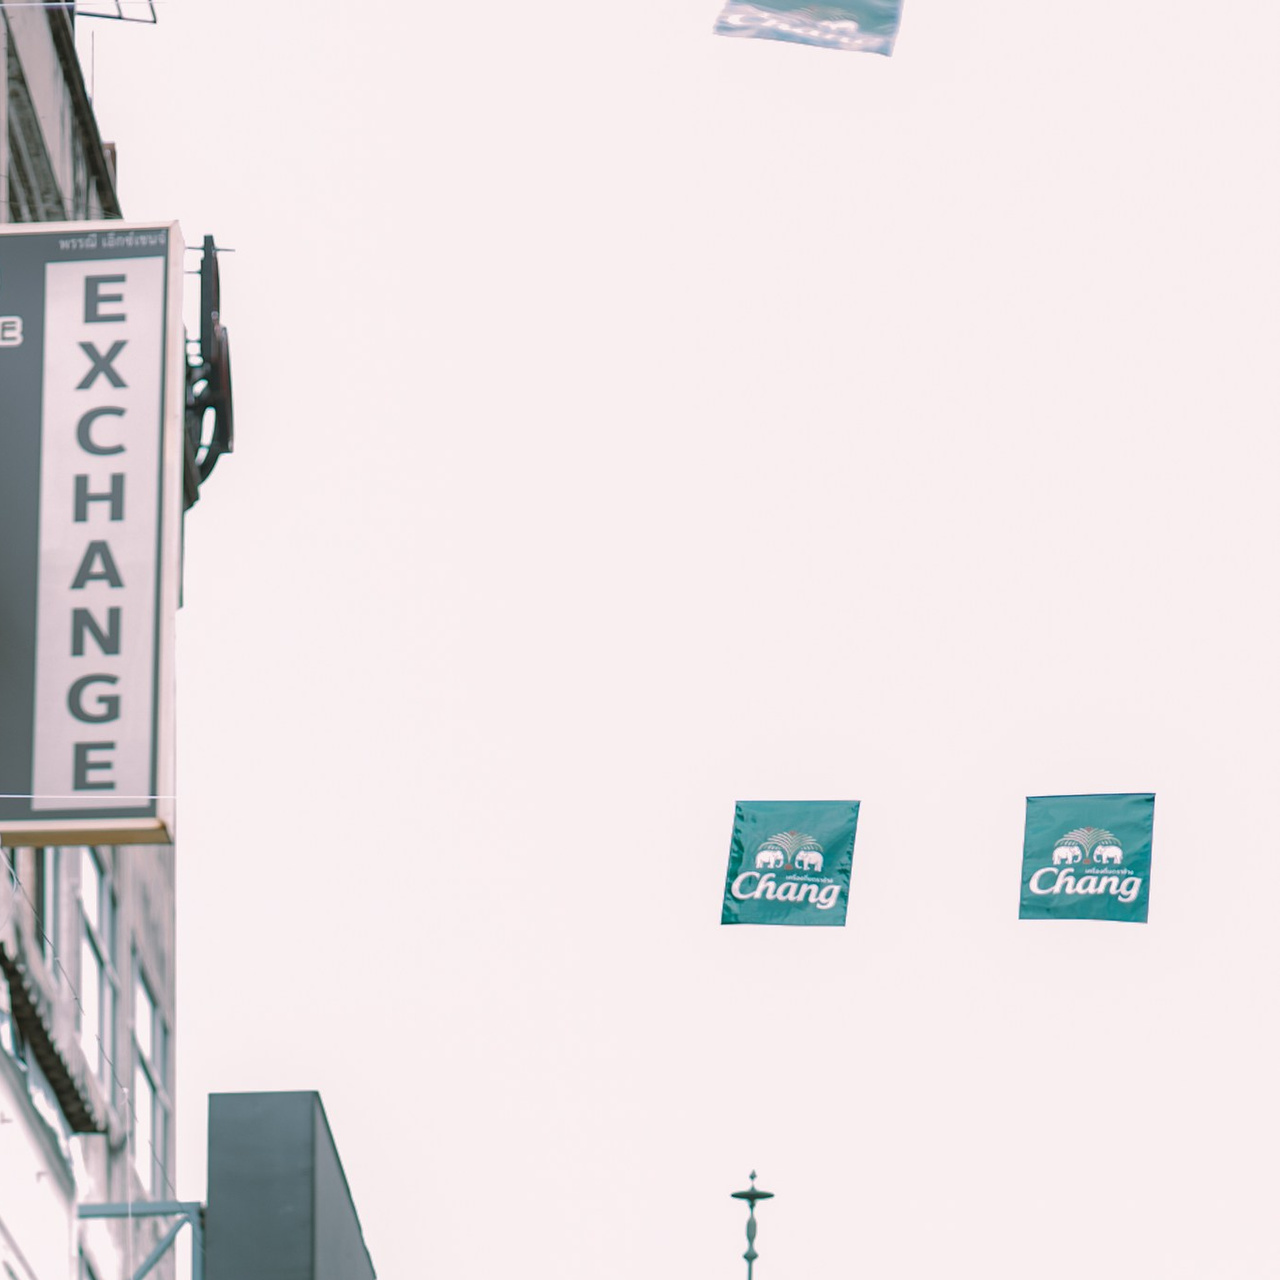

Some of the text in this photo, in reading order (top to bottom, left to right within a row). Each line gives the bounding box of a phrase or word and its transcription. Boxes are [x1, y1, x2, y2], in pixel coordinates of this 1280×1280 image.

[67, 273, 129, 792] EXCHANGE
[730, 871, 842, 910] Chang
[1028, 867, 1142, 903] Chang
